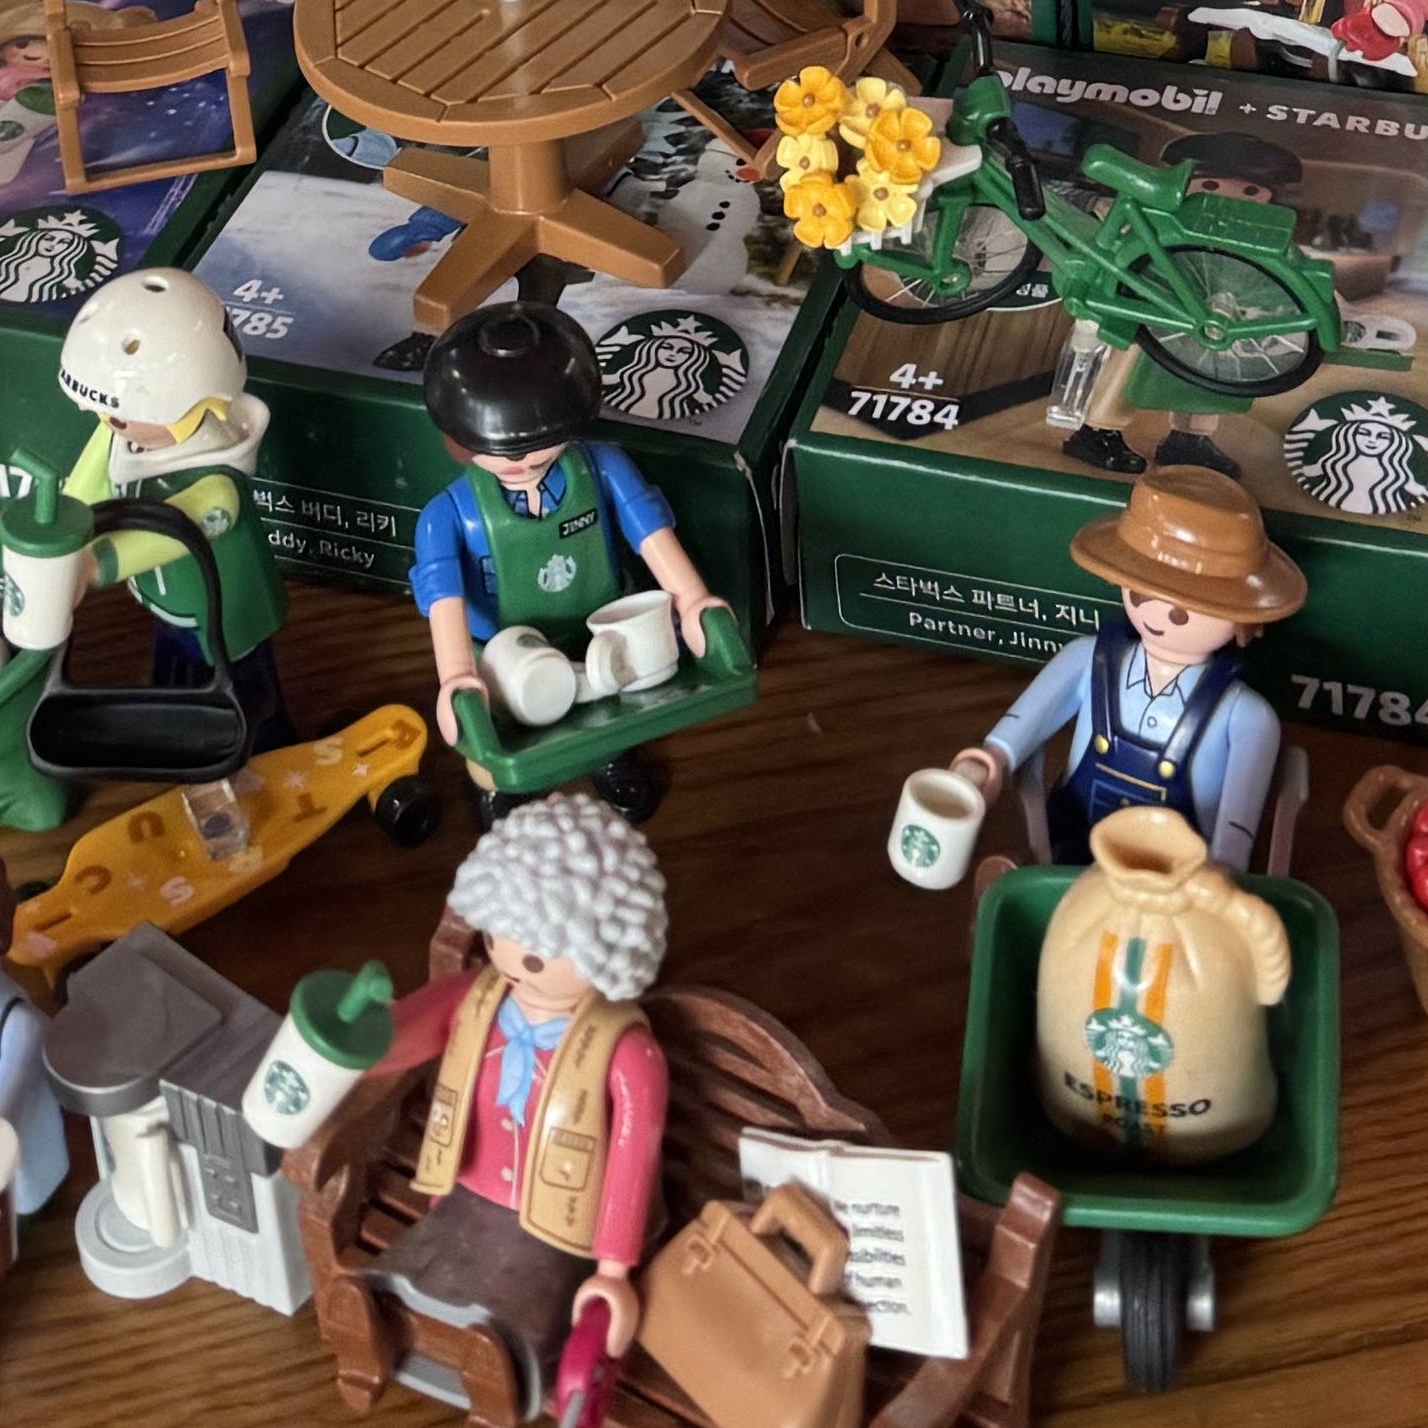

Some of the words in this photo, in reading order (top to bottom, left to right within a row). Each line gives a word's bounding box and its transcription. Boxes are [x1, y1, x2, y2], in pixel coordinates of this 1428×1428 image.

[232, 278, 285, 302] 4+
[227, 307, 294, 340] 785
[888, 360, 943, 394] 4+
[846, 388, 961, 433] 71784
[874, 572, 965, 604] 스타벅스
